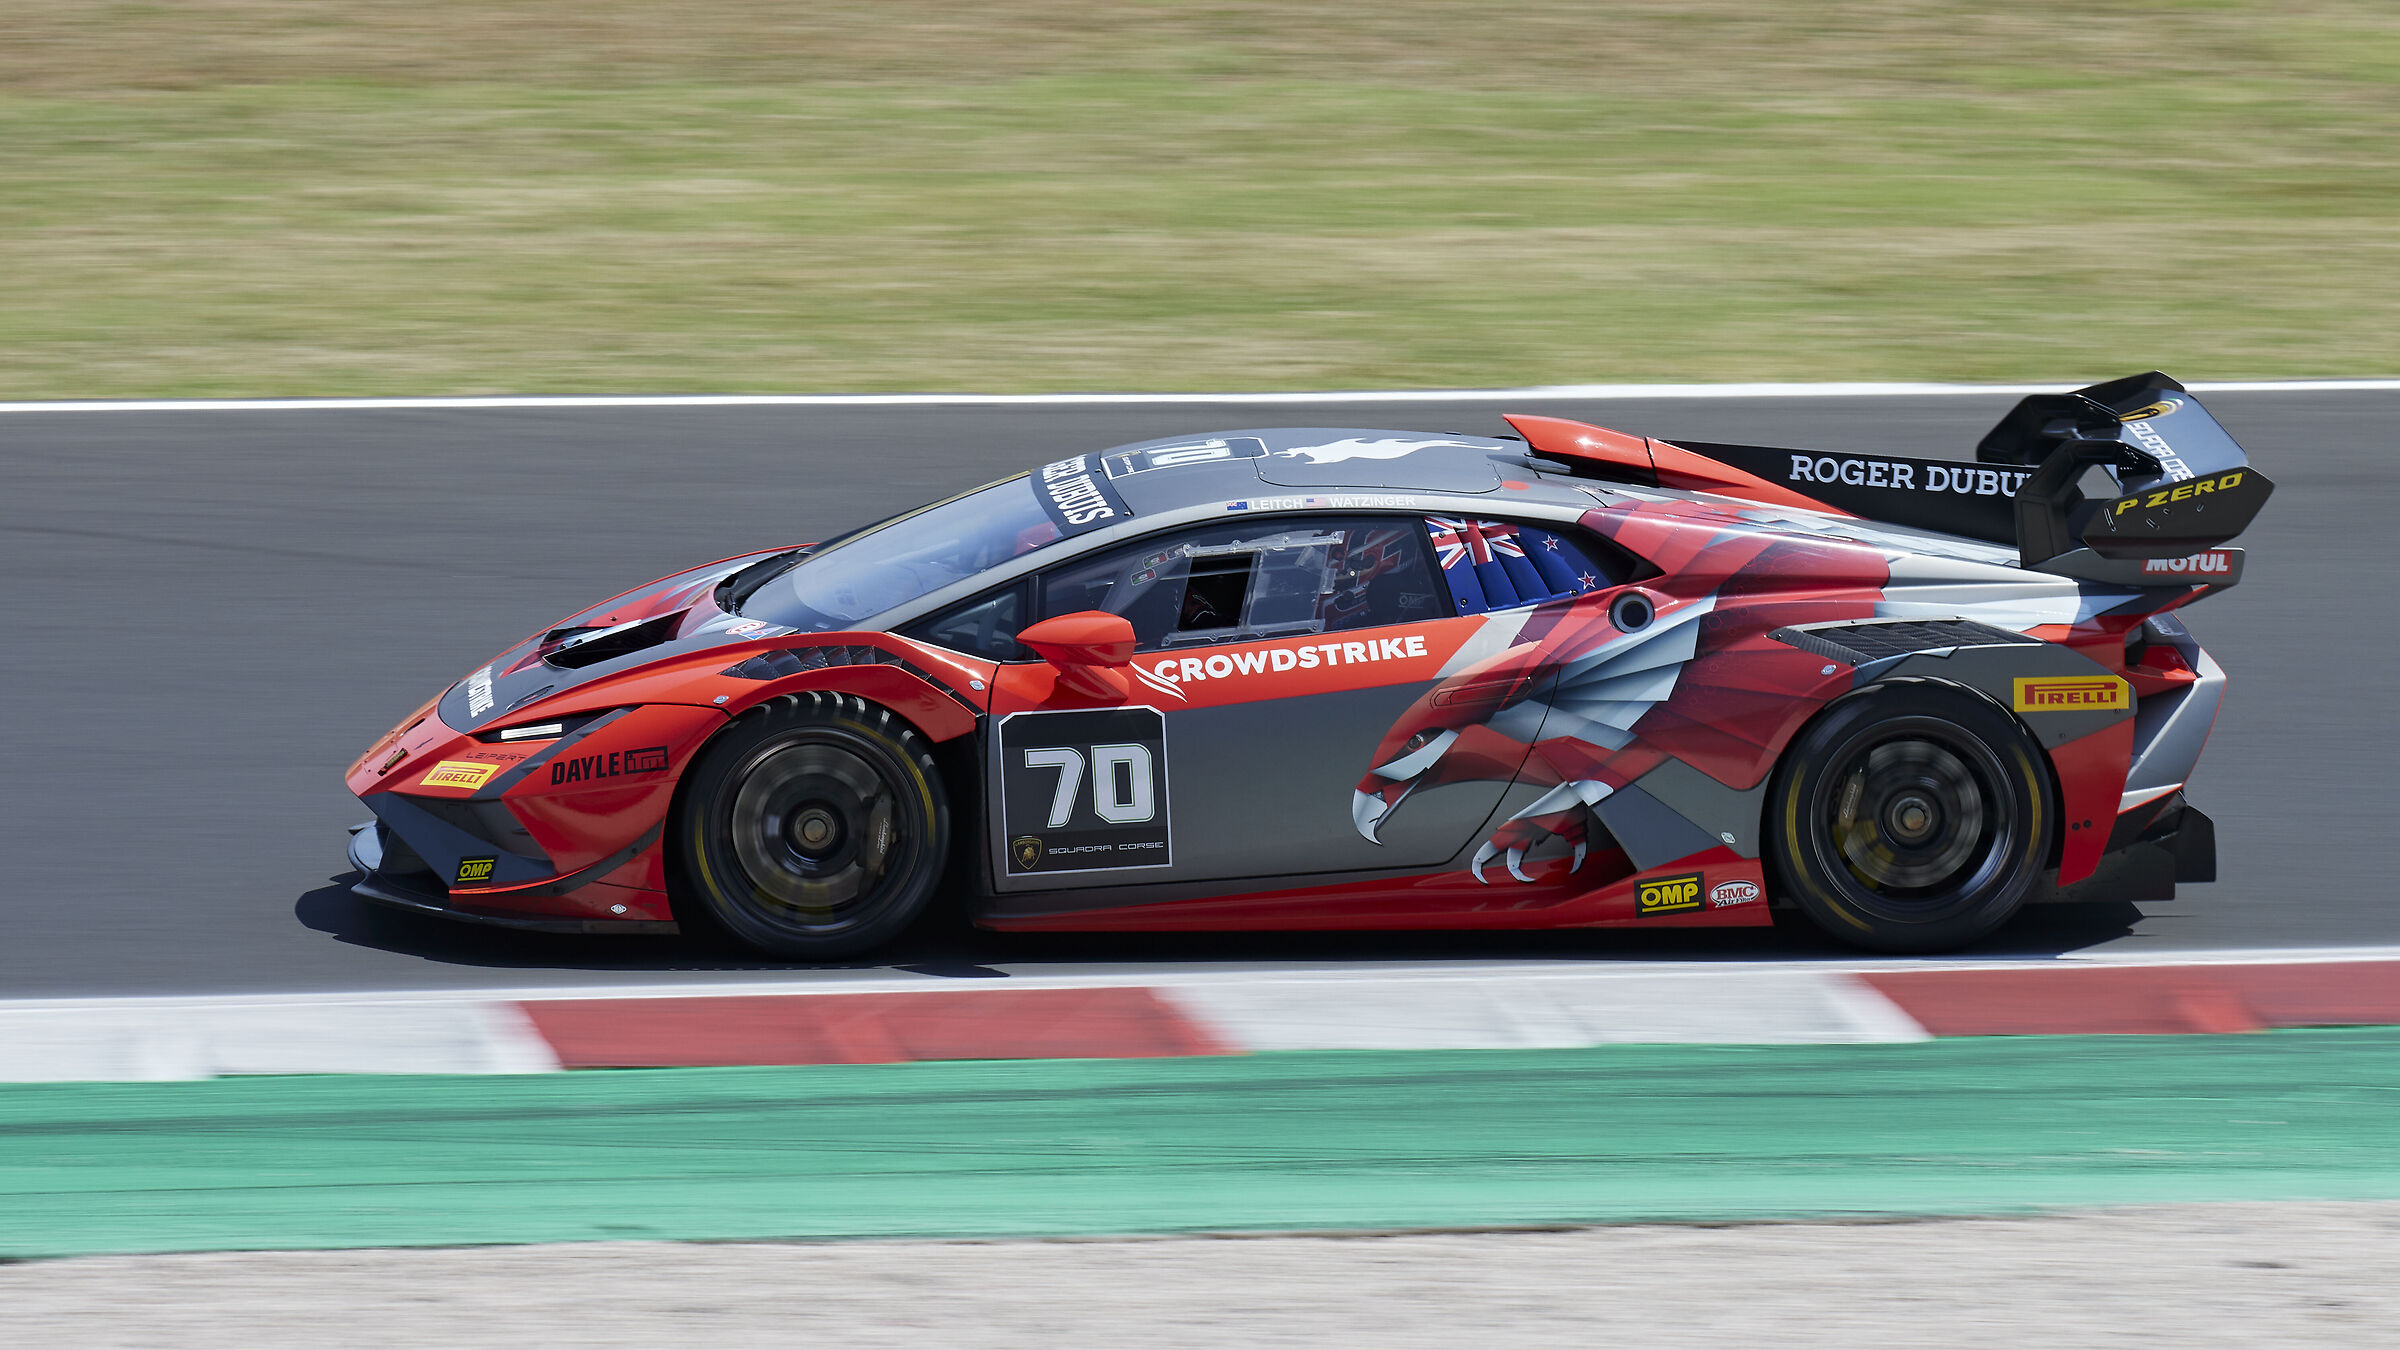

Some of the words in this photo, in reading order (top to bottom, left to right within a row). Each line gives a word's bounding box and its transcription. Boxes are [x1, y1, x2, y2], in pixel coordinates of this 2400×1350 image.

[1788, 454, 1916, 490] ROGER
[1924, 465, 2032, 498] DUBU
[1251, 498, 1304, 511] LEITCH
[1330, 496, 1416, 508] WATZINGER
[2115, 498, 2139, 516] P
[2145, 472, 2243, 509] ZERO
[2146, 553, 2228, 572] MOTUL
[1154, 635, 1428, 683] CROWDSTRIKE
[2024, 682, 2118, 705] PIRELLI
[430, 766, 489, 784] PIRELLI
[551, 752, 620, 786] DAYLE
[1024, 743, 1155, 829] 70
[1048, 844, 1112, 855] SQUADRA
[1118, 841, 1164, 851] CORSE
[460, 863, 493, 877] OMP
[1640, 883, 1699, 907] OMP
[1716, 885, 1755, 900] BMC
